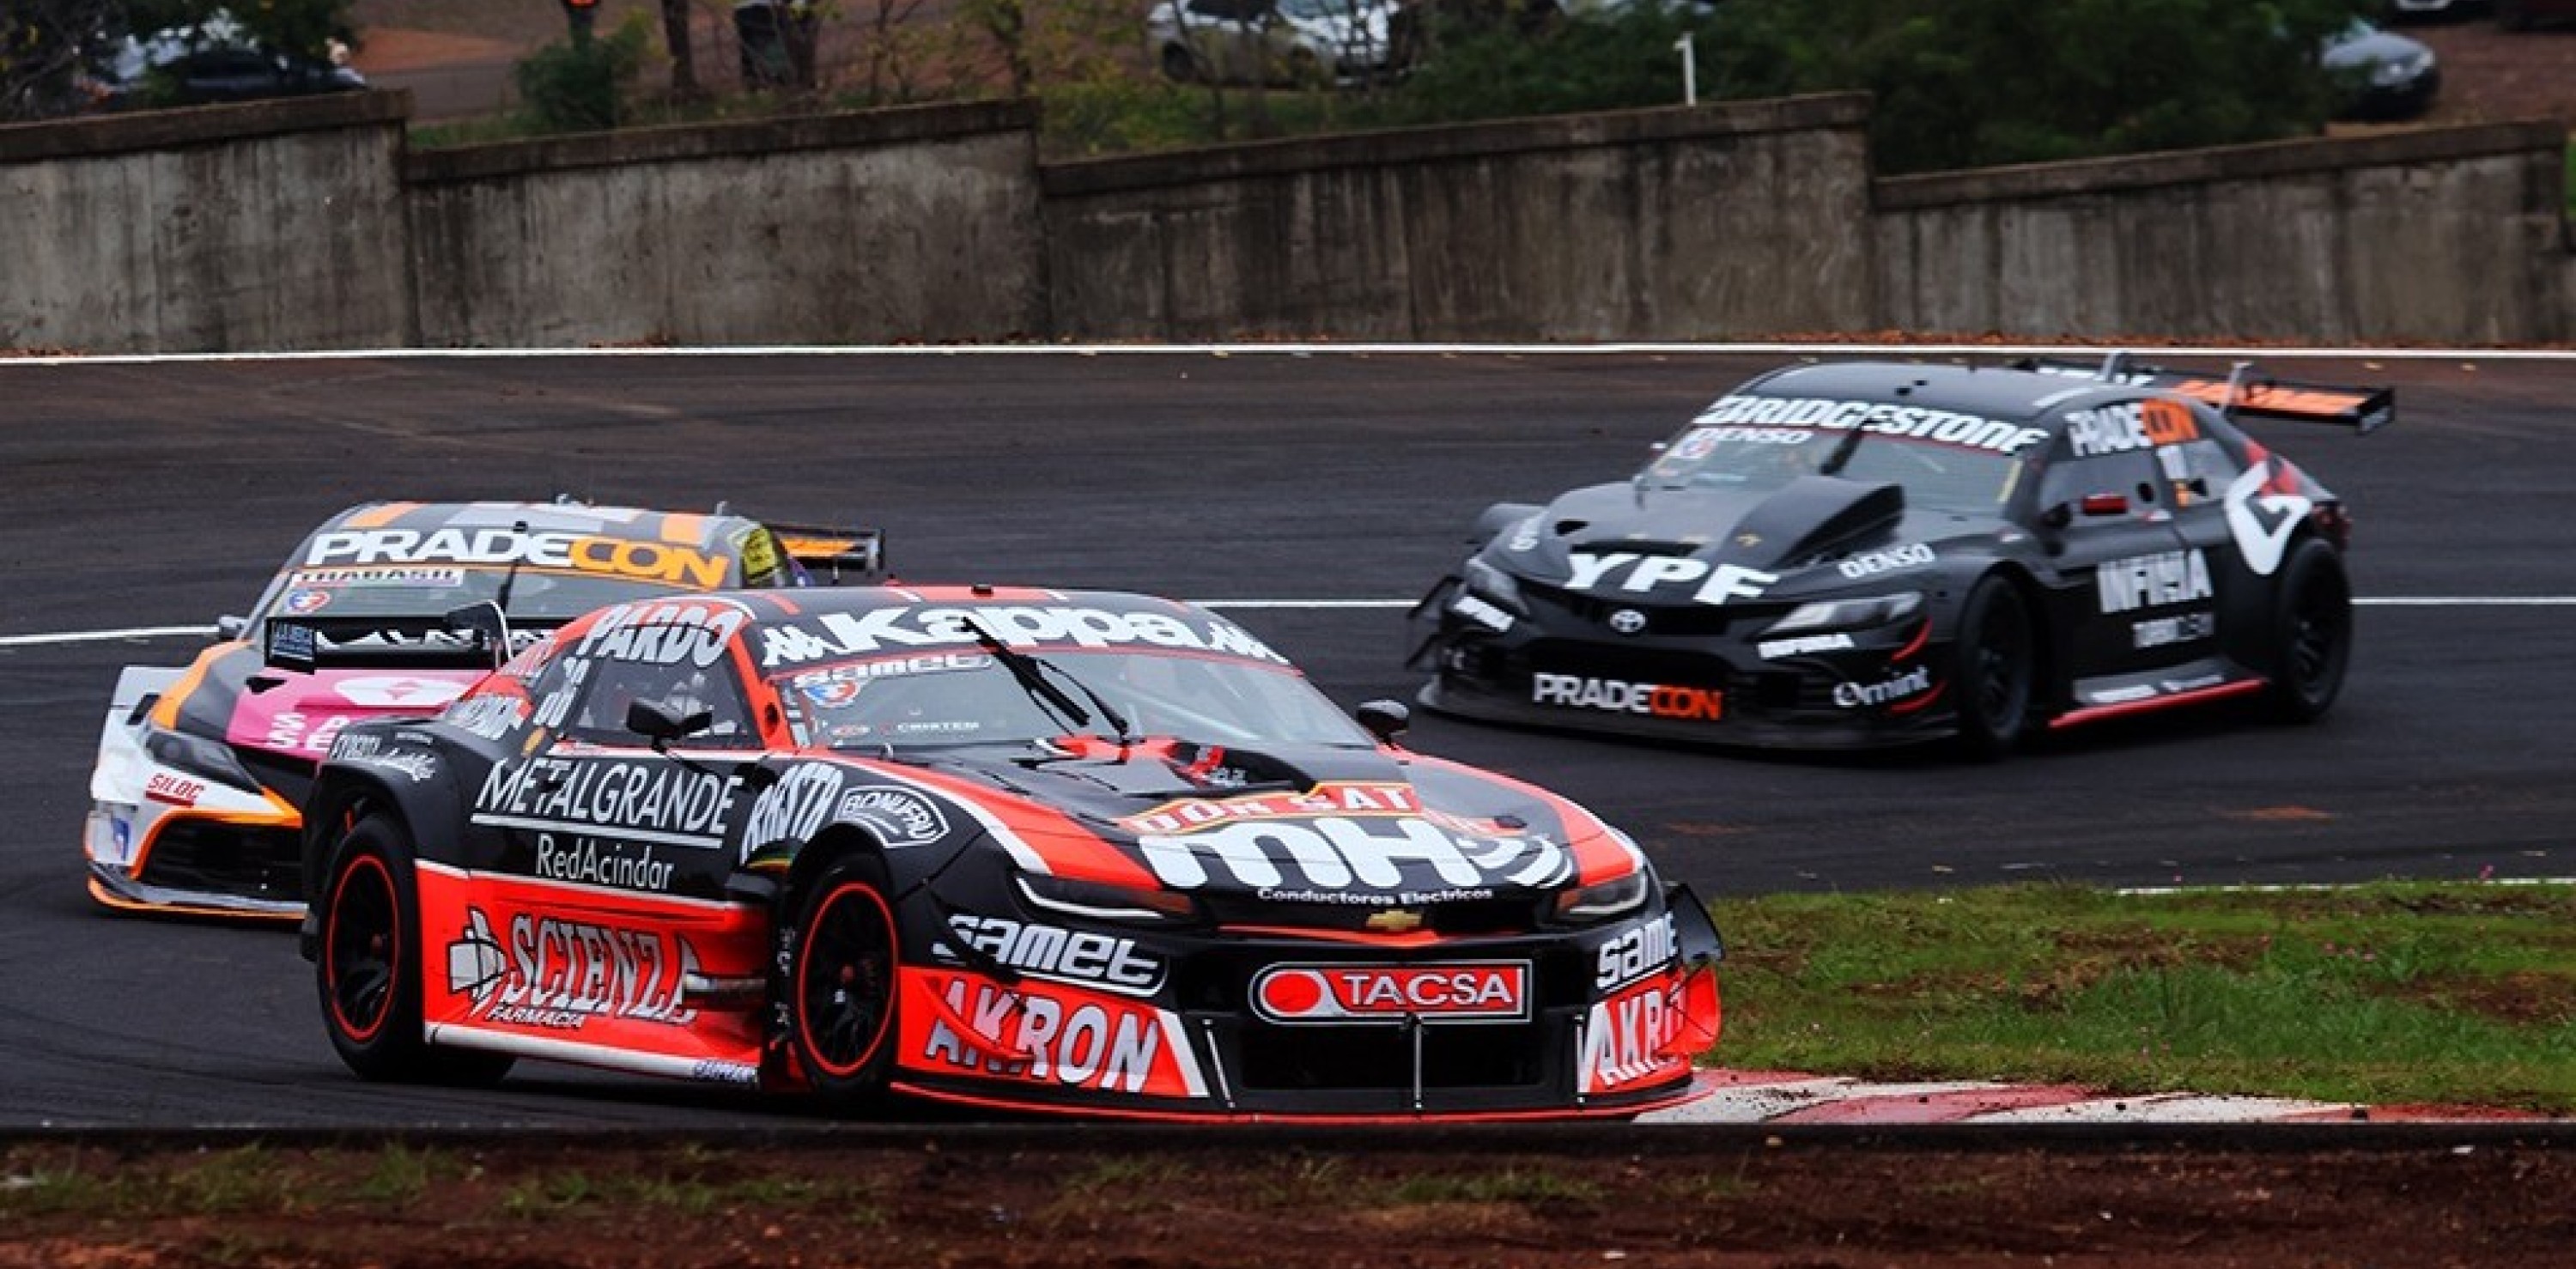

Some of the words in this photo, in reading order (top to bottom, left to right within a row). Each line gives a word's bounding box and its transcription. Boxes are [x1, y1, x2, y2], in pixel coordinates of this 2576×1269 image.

[1692, 395, 2050, 452] BRIDGESTONE
[306, 528, 730, 591] PRADECON
[1564, 554, 1778, 604] YPF
[1838, 543, 1935, 579] DENSO
[577, 604, 743, 666] PARDO
[818, 606, 1209, 650] Kappa
[1533, 672, 1723, 720] PRADECON
[475, 757, 742, 835] METALGRANDE
[535, 833, 675, 890] RedAcindar
[1343, 974, 1513, 1006] TACSA
[925, 979, 1158, 1093] AKRON
